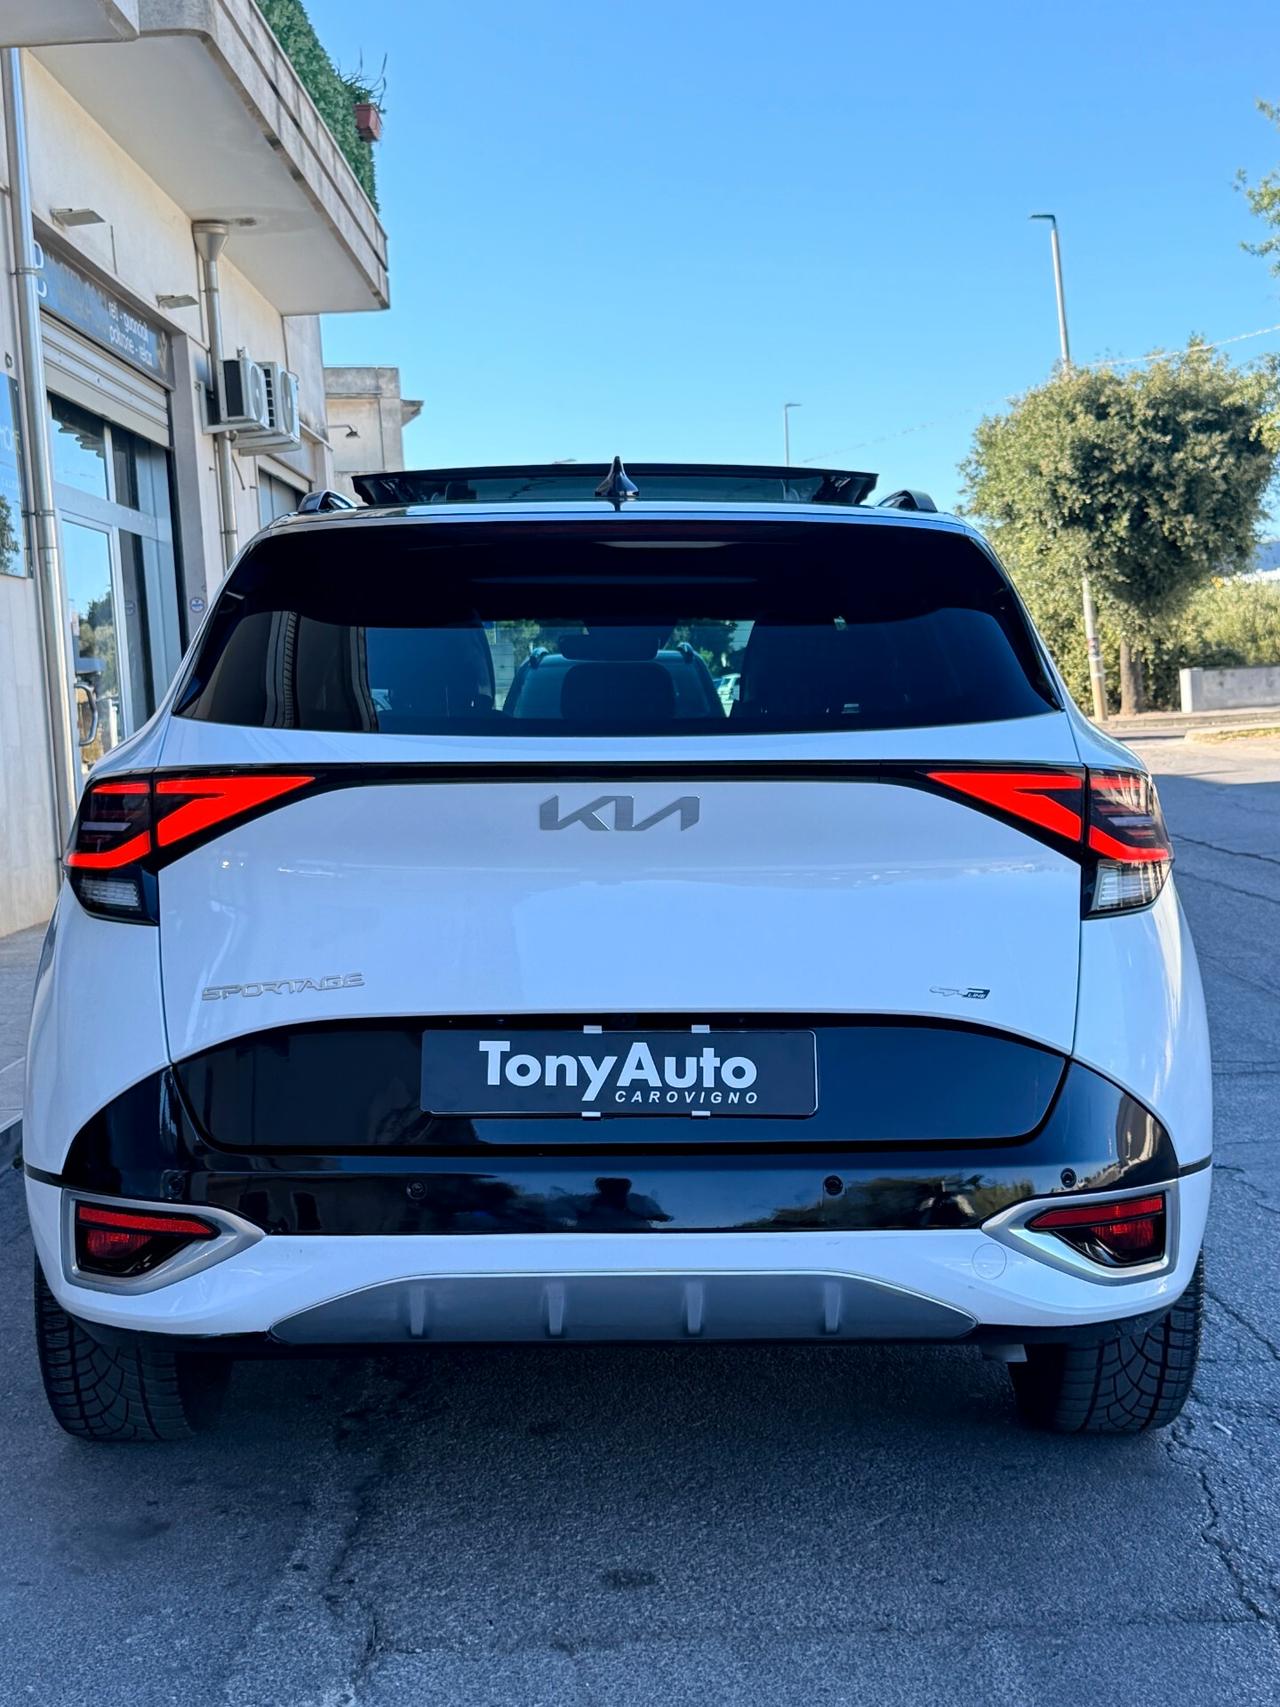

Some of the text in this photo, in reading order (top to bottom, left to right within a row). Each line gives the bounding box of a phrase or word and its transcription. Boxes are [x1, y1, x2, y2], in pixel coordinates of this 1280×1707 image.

[539, 794, 701, 832] KIA
[201, 972, 366, 1002] SPORTAGE
[478, 1040, 758, 1102] TonyAuto
[614, 1090, 759, 1105] CAROVIGNO
